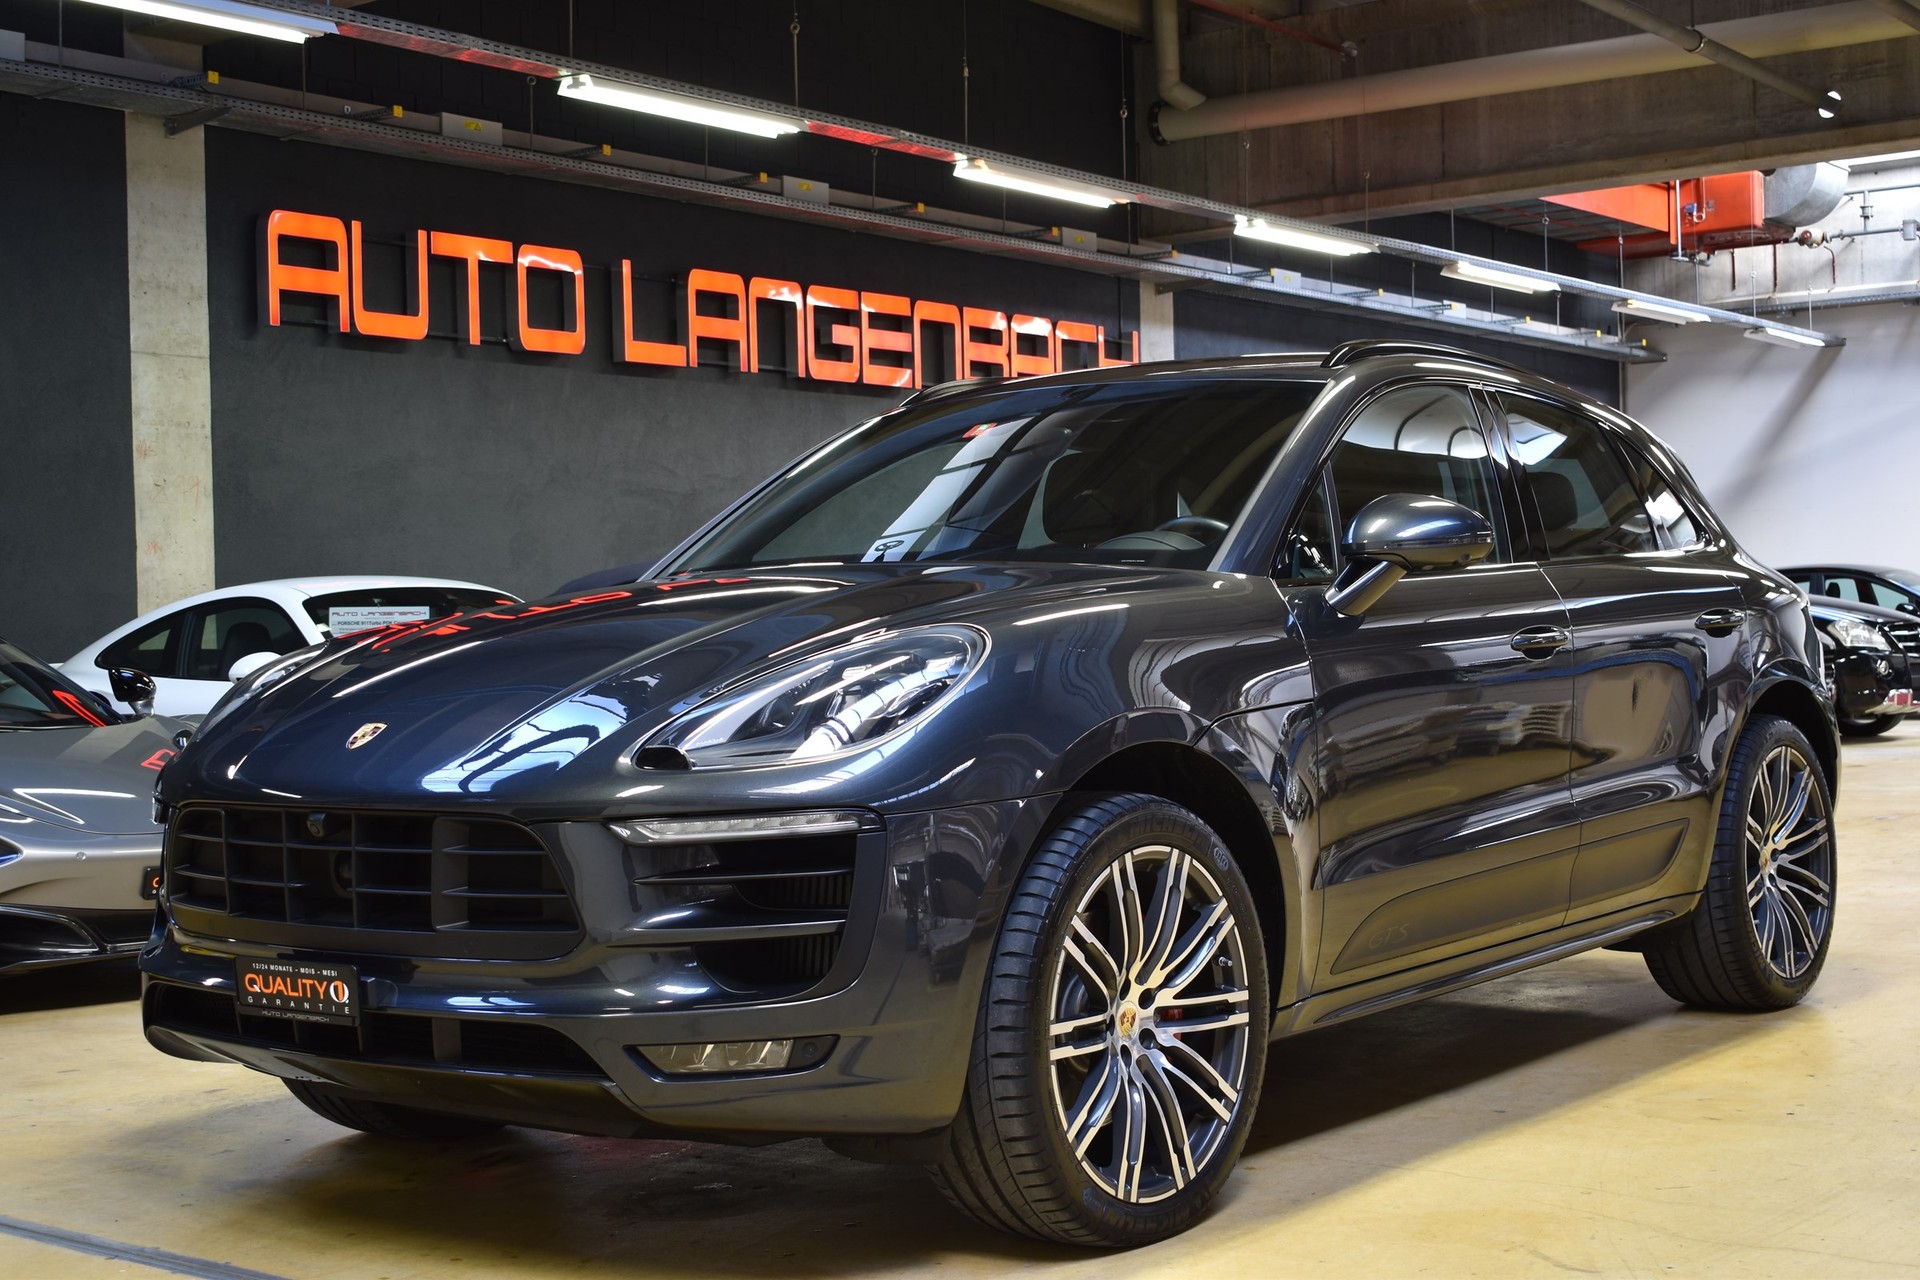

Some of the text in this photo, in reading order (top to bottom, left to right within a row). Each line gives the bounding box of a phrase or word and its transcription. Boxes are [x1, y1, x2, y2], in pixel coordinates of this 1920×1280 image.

[267, 209, 586, 355] AUTO
[1369, 922, 1410, 949] GTS
[270, 964, 293, 973] MONATE
[300, 967, 315, 975] MOIS
[322, 969, 338, 977] MESI
[245, 973, 328, 1000] QUALITY
[248, 996, 350, 1014] GARANTIE
[282, 1012, 330, 1022] LANGENBACH
